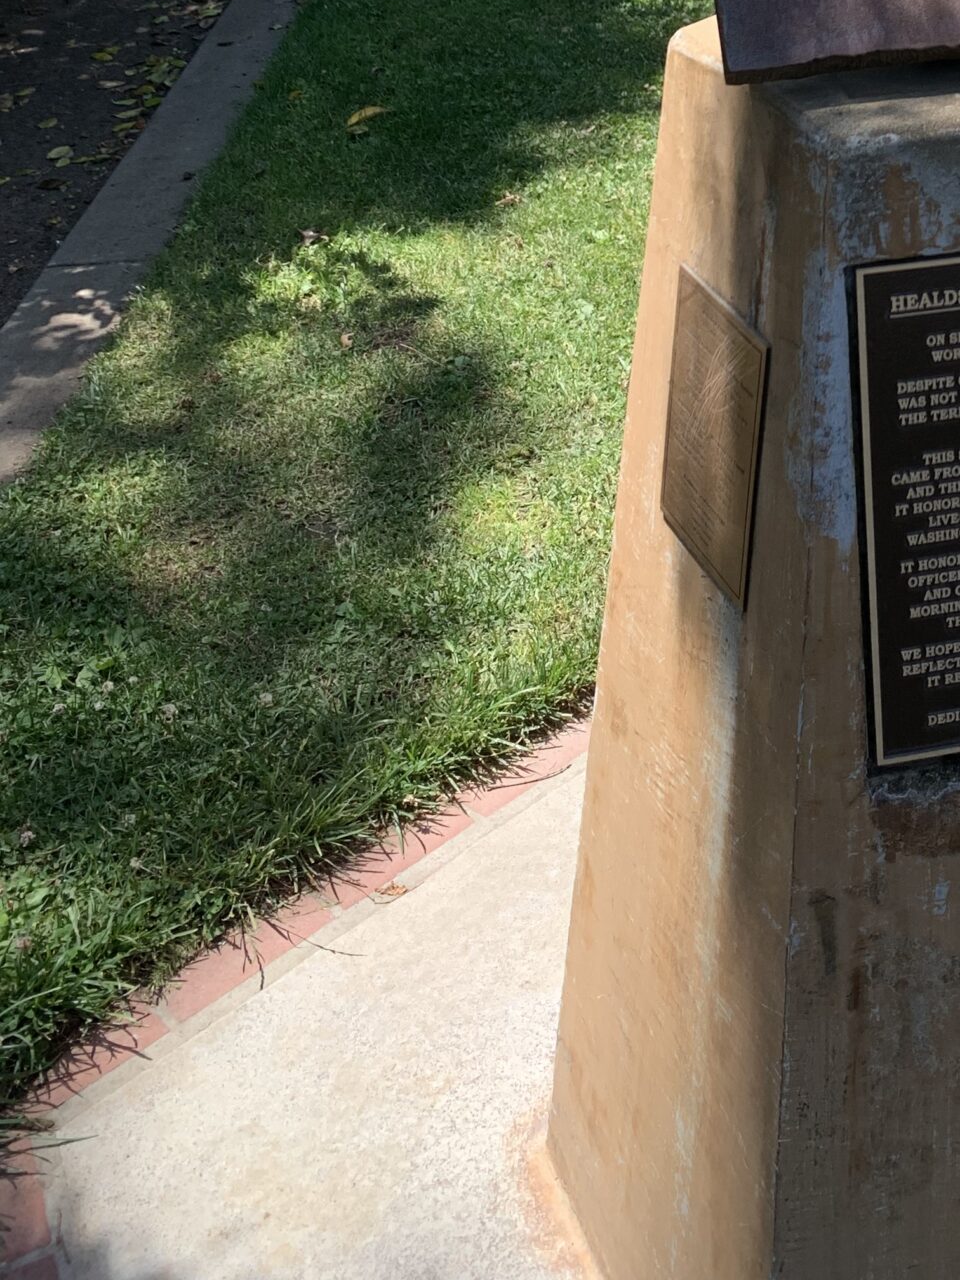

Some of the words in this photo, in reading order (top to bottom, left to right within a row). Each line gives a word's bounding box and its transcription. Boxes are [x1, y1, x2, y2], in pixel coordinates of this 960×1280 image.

[926, 335, 945, 348] ON
[897, 376, 955, 394] DESPITE
[898, 397, 926, 410] WAS
[931, 393, 957, 406] NOT
[899, 412, 928, 427] THE
[923, 451, 955, 466] THIS
[891, 470, 930, 486] CAME
[906, 485, 935, 499] AND
[895, 504, 909, 517] IT
[900, 562, 915, 574] IT
[923, 586, 952, 601] AND
[901, 648, 922, 662] WE
[927, 674, 941, 688] IT
